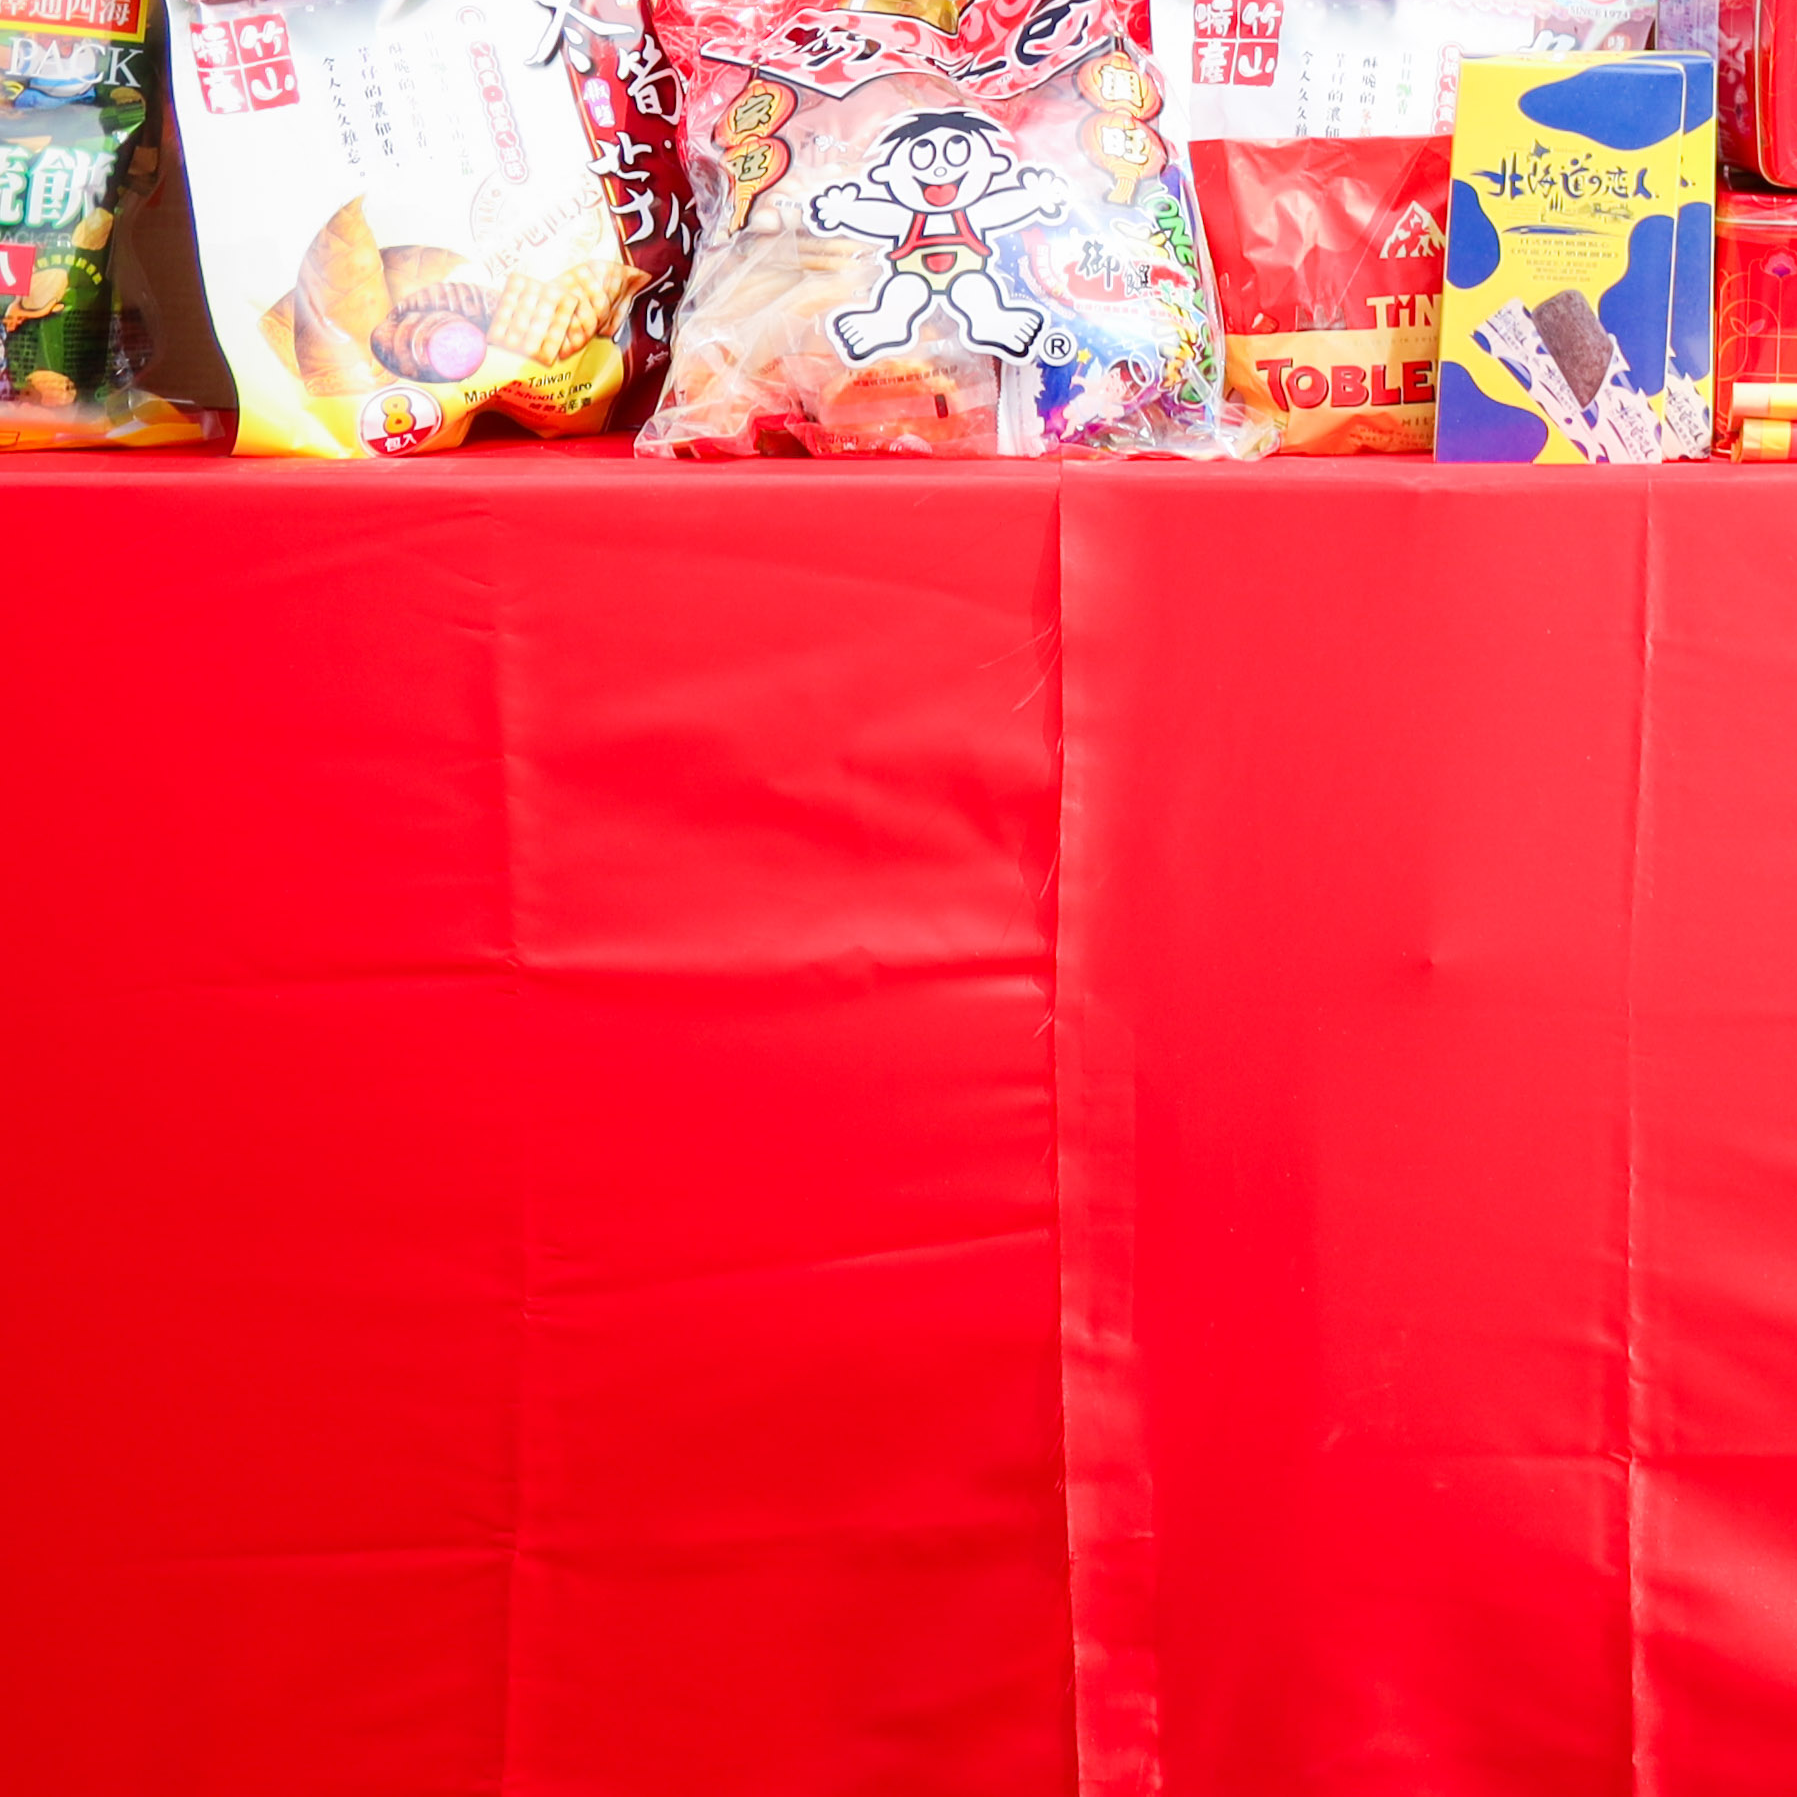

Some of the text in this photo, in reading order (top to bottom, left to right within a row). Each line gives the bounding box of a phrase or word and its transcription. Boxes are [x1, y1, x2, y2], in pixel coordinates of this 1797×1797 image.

[5, 35, 144, 88] PACK
[1238, 2, 1281, 77] 竹山
[1257, 356, 1436, 411] TOBLE
[381, 393, 418, 436] 8
[384, 433, 418, 452] 包入
